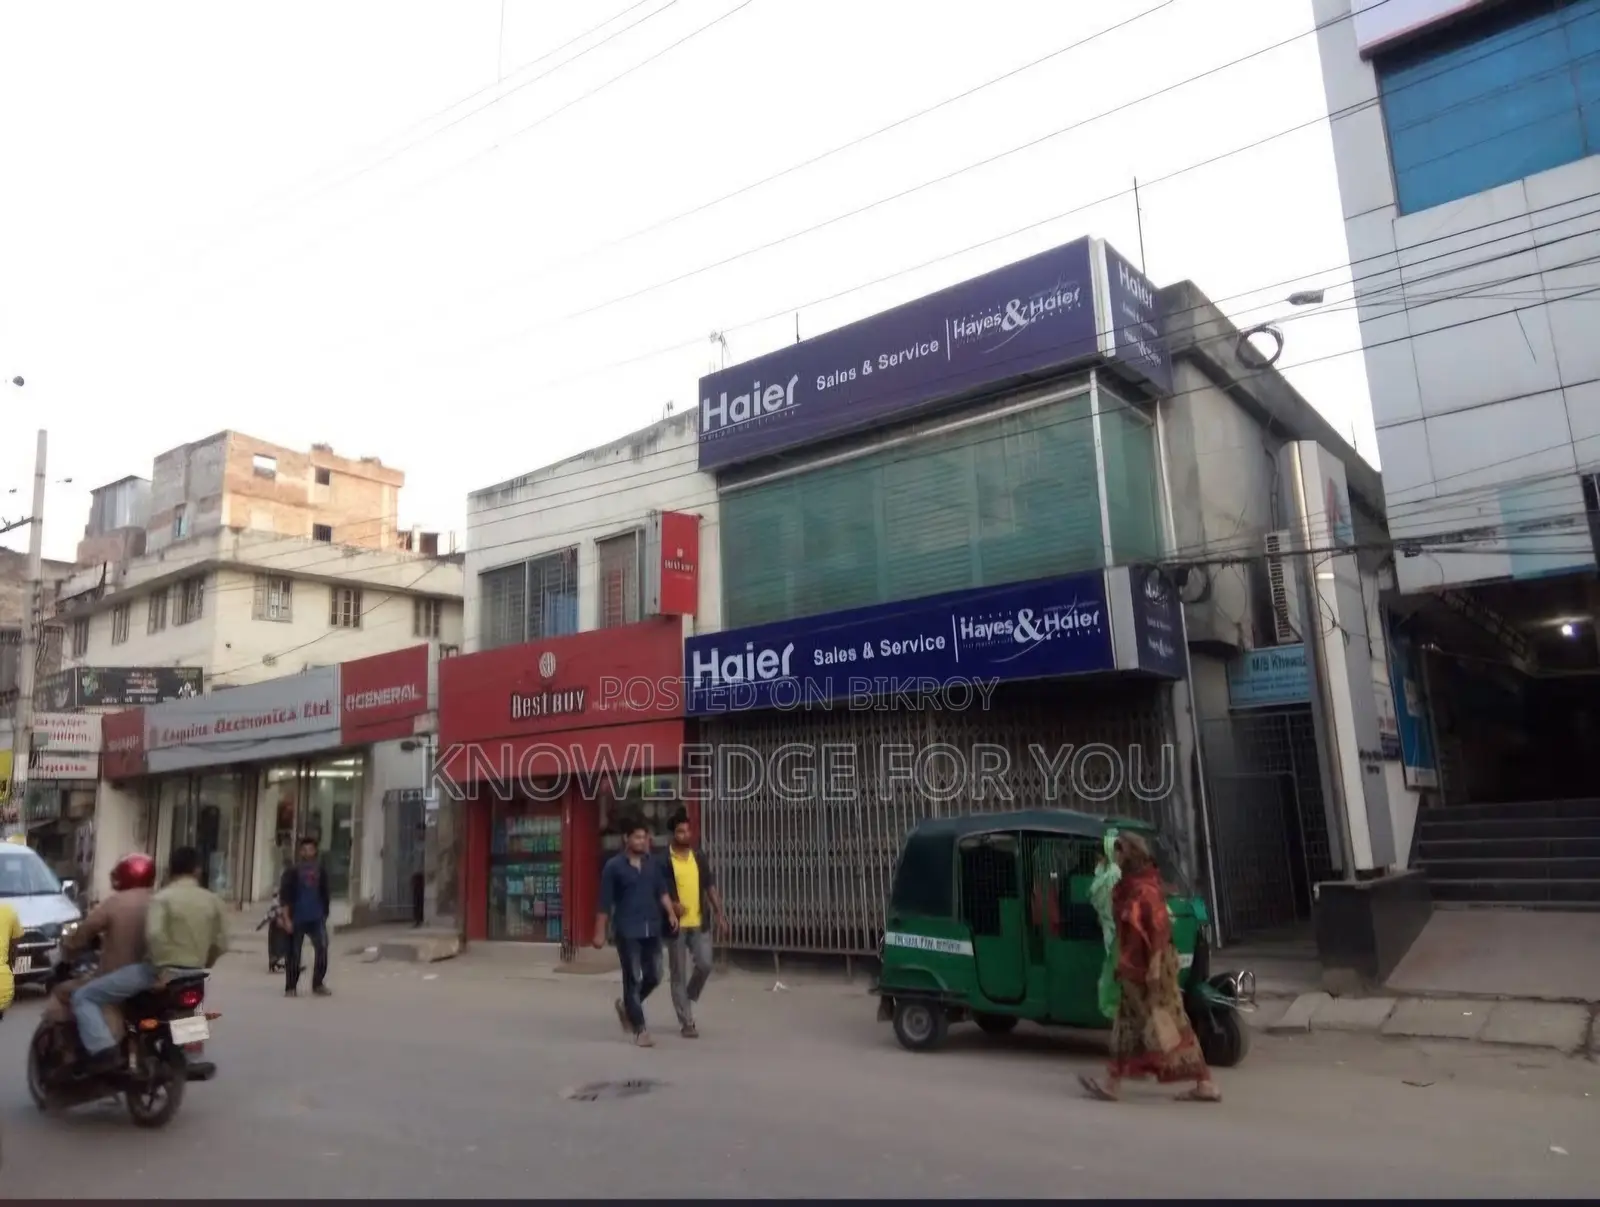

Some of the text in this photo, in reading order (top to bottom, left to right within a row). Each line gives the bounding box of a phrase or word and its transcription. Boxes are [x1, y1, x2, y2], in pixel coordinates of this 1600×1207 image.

[953, 287, 1081, 341] Hayes & Haier
[816, 340, 940, 391] Sales & Service
[702, 374, 799, 432] Haier
[960, 616, 1014, 641] Hayes
[1013, 608, 1044, 643] &
[1044, 609, 1100, 633] Haier
[692, 642, 795, 689] Haier
[813, 646, 857, 666] Sales
[862, 641, 875, 660] &
[880, 634, 946, 657] Service
[511, 690, 549, 719] Best
[552, 688, 585, 714] BUY
